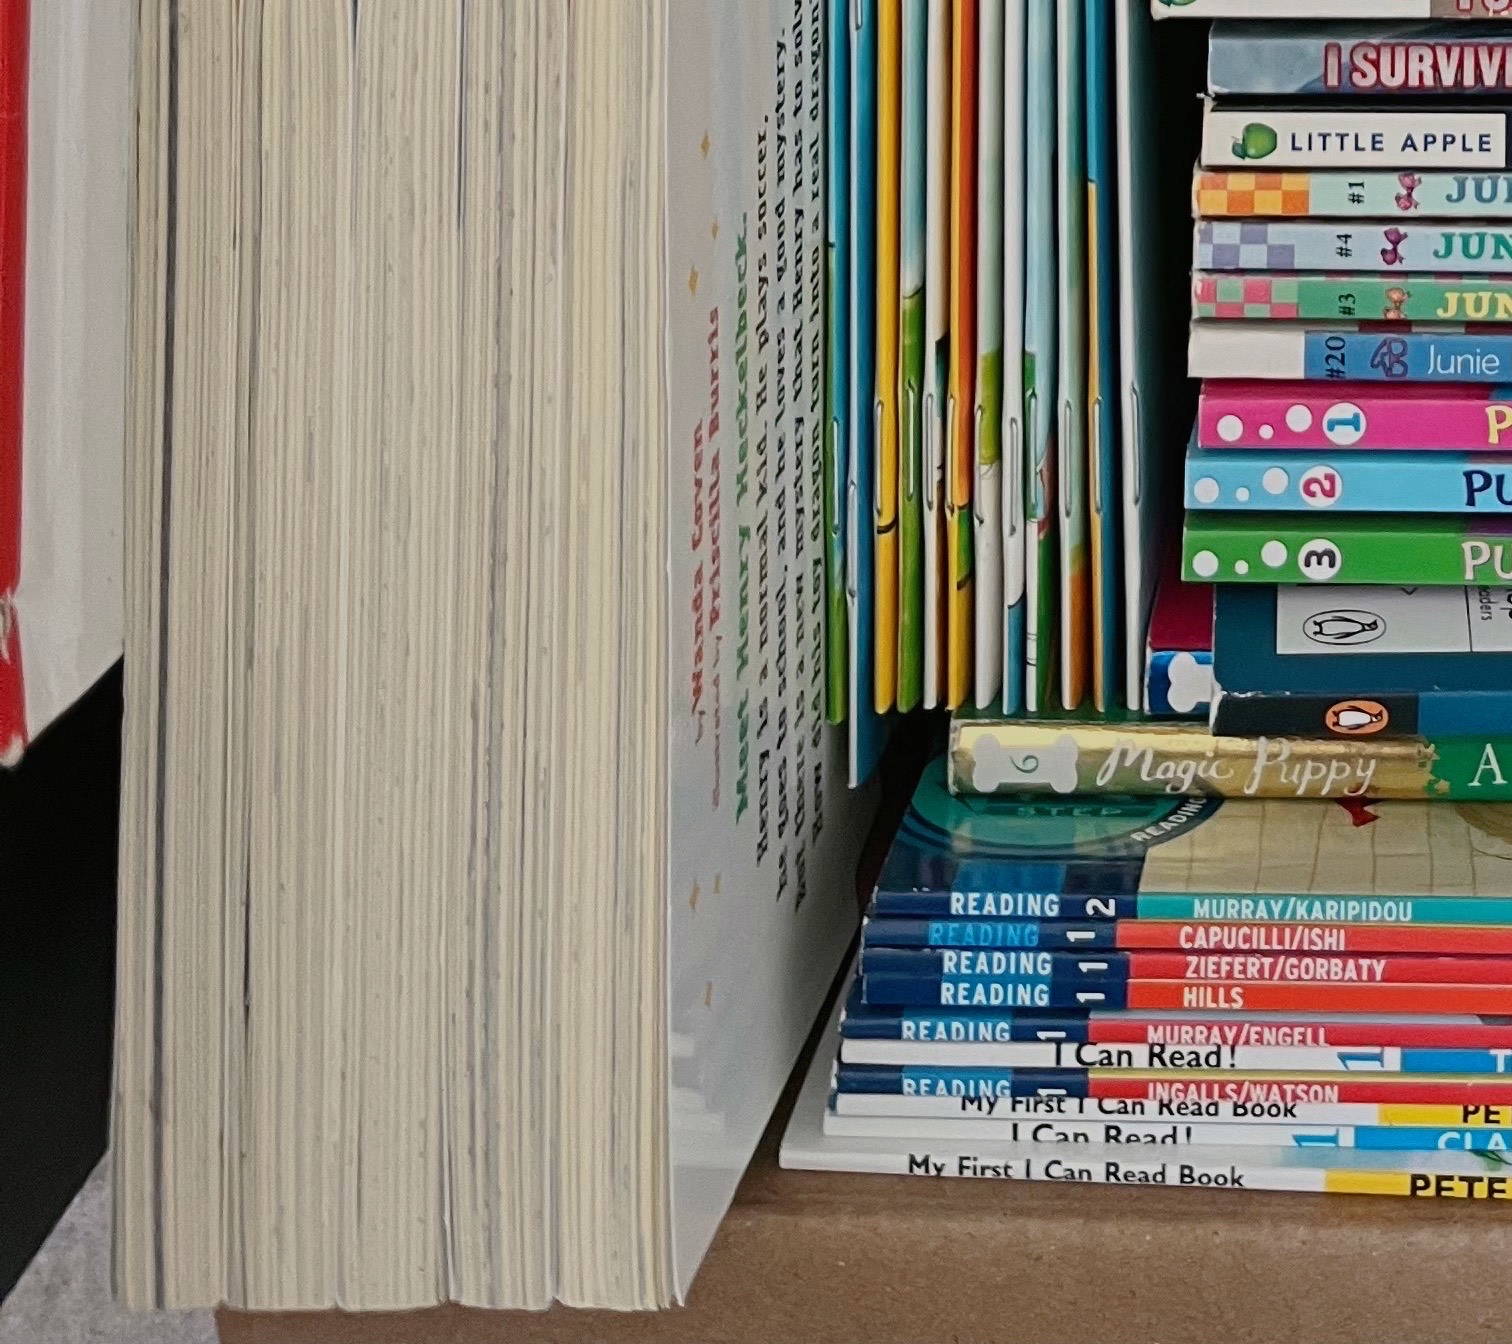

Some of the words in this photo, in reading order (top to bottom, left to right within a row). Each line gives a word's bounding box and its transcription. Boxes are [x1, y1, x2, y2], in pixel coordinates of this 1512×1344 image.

[1324, 44, 1342, 88] I
[1290, 132, 1384, 153] LITTLE
[1400, 132, 1491, 153] APPLE
[1098, 745, 1232, 791] Magic
[1245, 737, 1377, 795] Puppy
[1468, 749, 1504, 787] A
[951, 893, 1059, 917] READING
[1086, 898, 1114, 916] 2
[1194, 898, 1413, 922] MURRAY/KARIPIDOU
